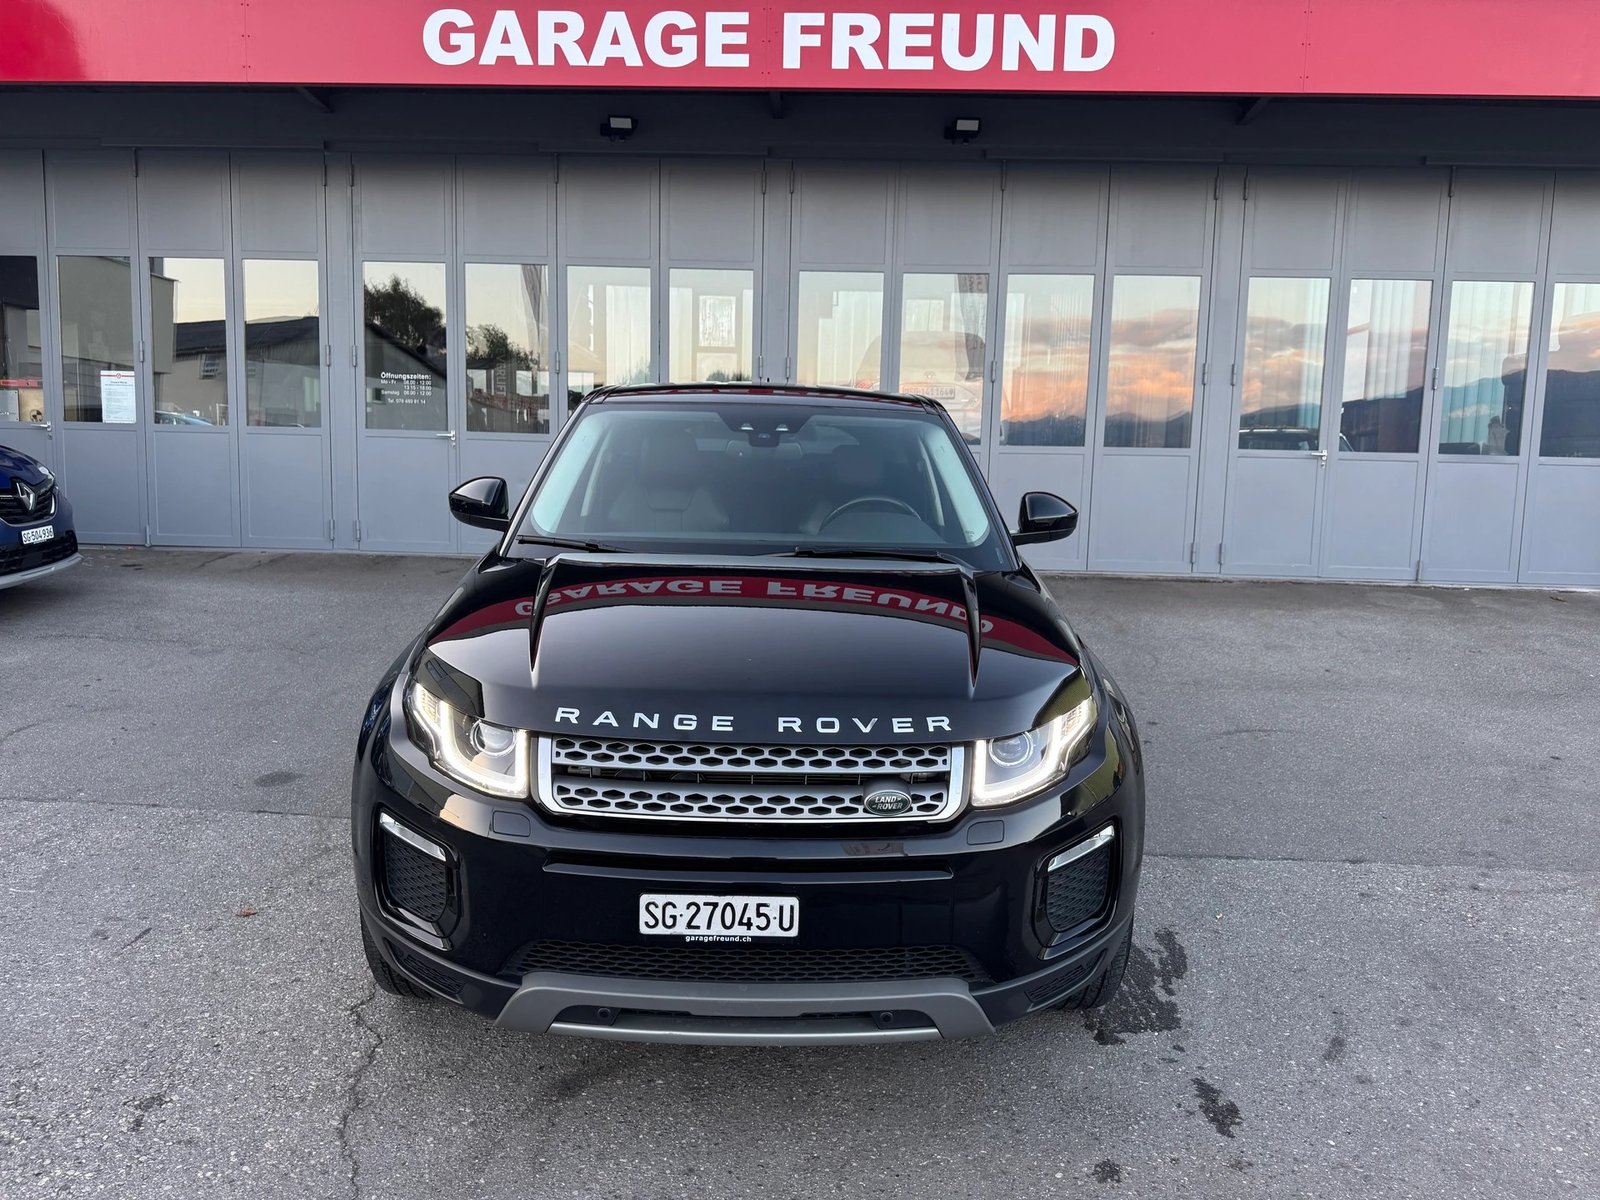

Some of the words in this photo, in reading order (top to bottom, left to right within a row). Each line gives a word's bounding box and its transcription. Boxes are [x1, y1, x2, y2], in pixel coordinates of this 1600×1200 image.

[422, 8, 750, 68] GARAGE
[782, 12, 1115, 72] FREUND
[380, 371, 432, 380] Öffnungszeiten:
[554, 706, 735, 732] RANGE
[777, 715, 953, 734] ROVER
[876, 802, 903, 810] ROVER
[685, 935, 752, 943] garagefreund.ch
